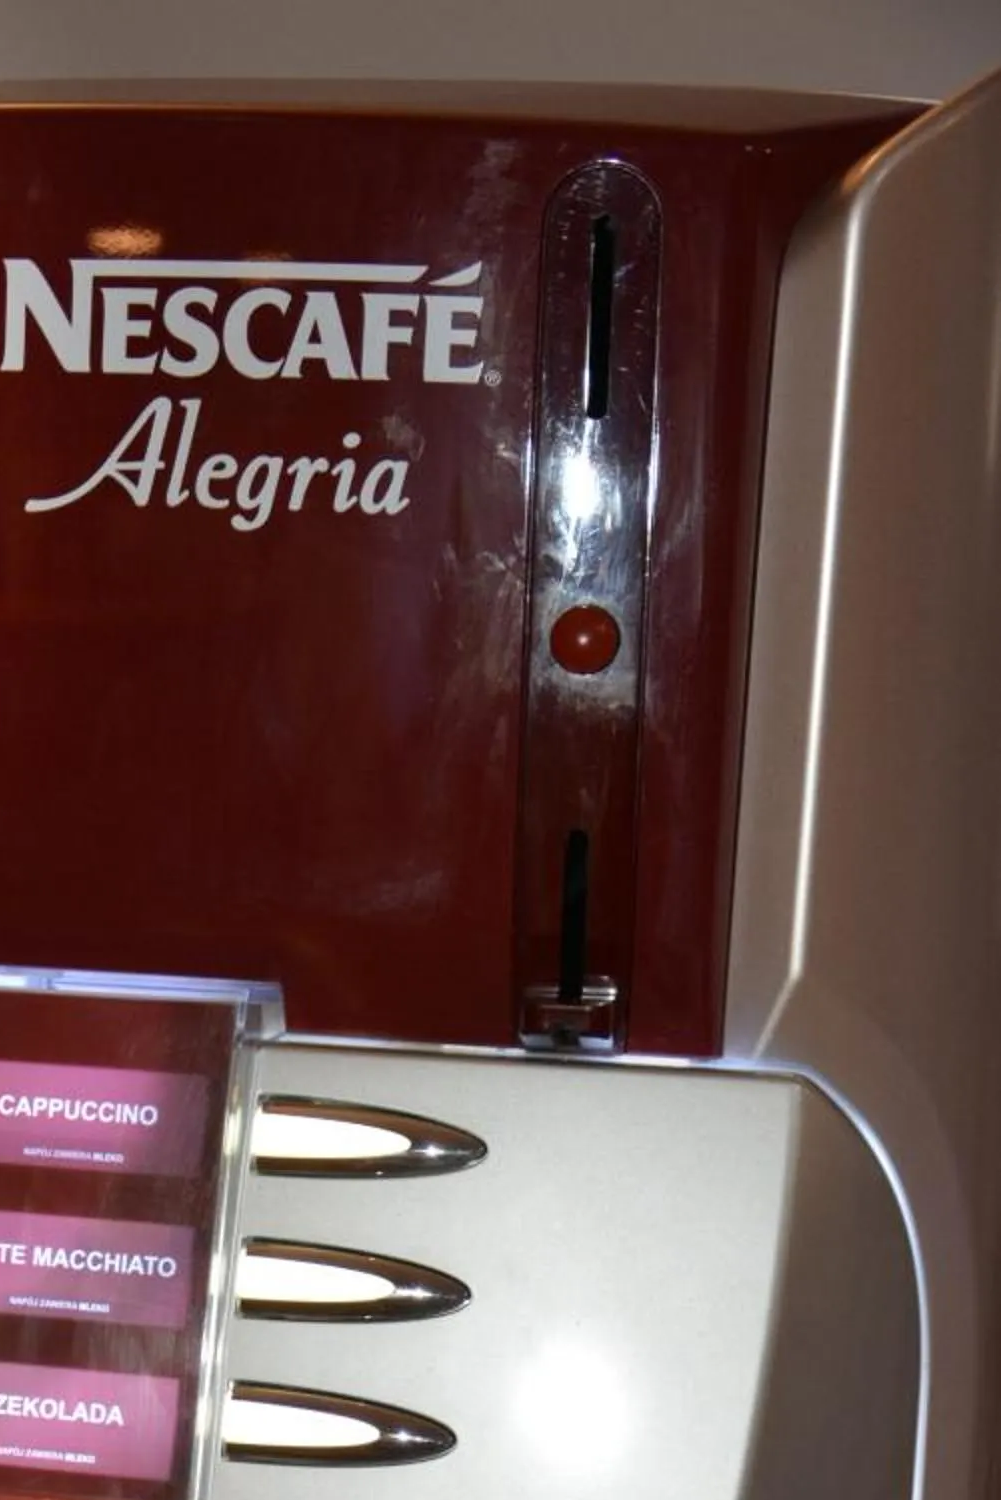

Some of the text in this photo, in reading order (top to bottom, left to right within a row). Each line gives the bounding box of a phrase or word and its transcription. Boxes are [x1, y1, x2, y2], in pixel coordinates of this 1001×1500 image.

[0, 258, 485, 383] NESCAFÉ
[24, 396, 412, 532] Alegria
[32, 1246, 177, 1278] MACCHIATO
